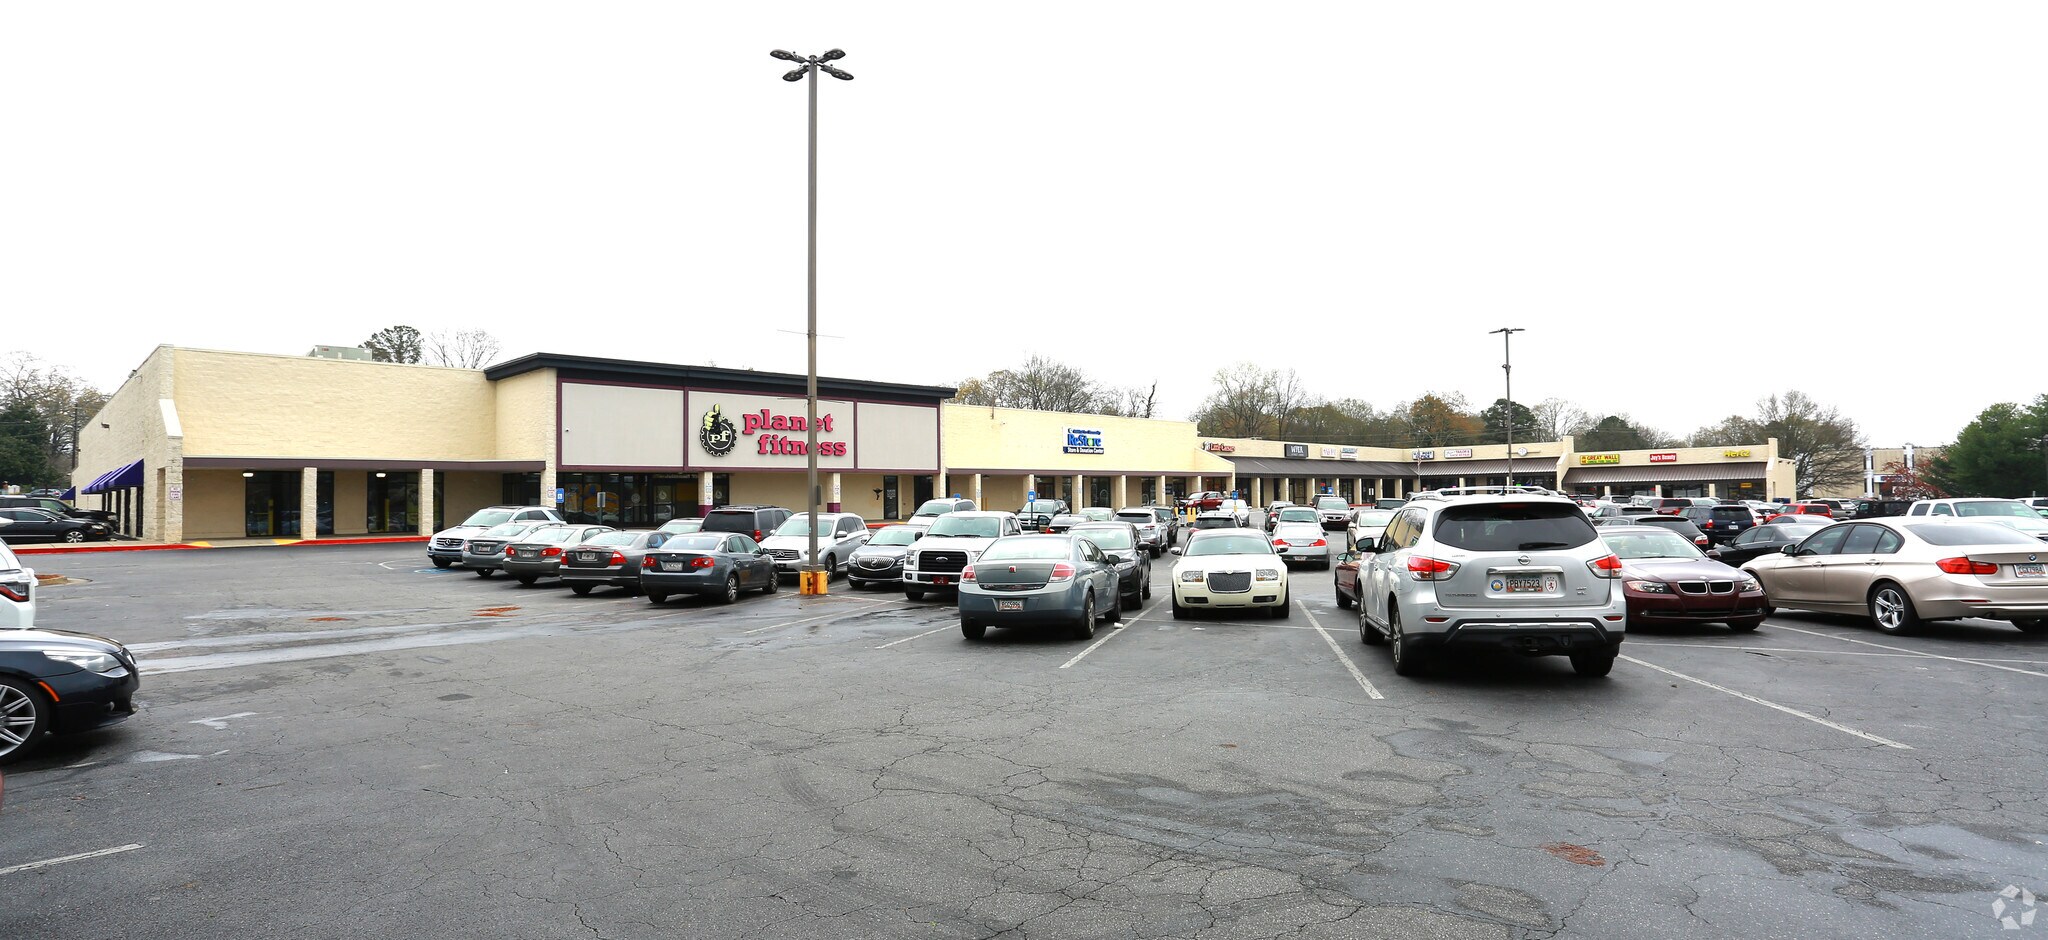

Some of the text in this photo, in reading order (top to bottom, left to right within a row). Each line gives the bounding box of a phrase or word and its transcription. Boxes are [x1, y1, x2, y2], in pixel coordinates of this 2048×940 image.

[709, 430, 730, 444] pf
[1067, 433, 1102, 447] ReStore
[1510, 578, 1541, 589] PBY7523
